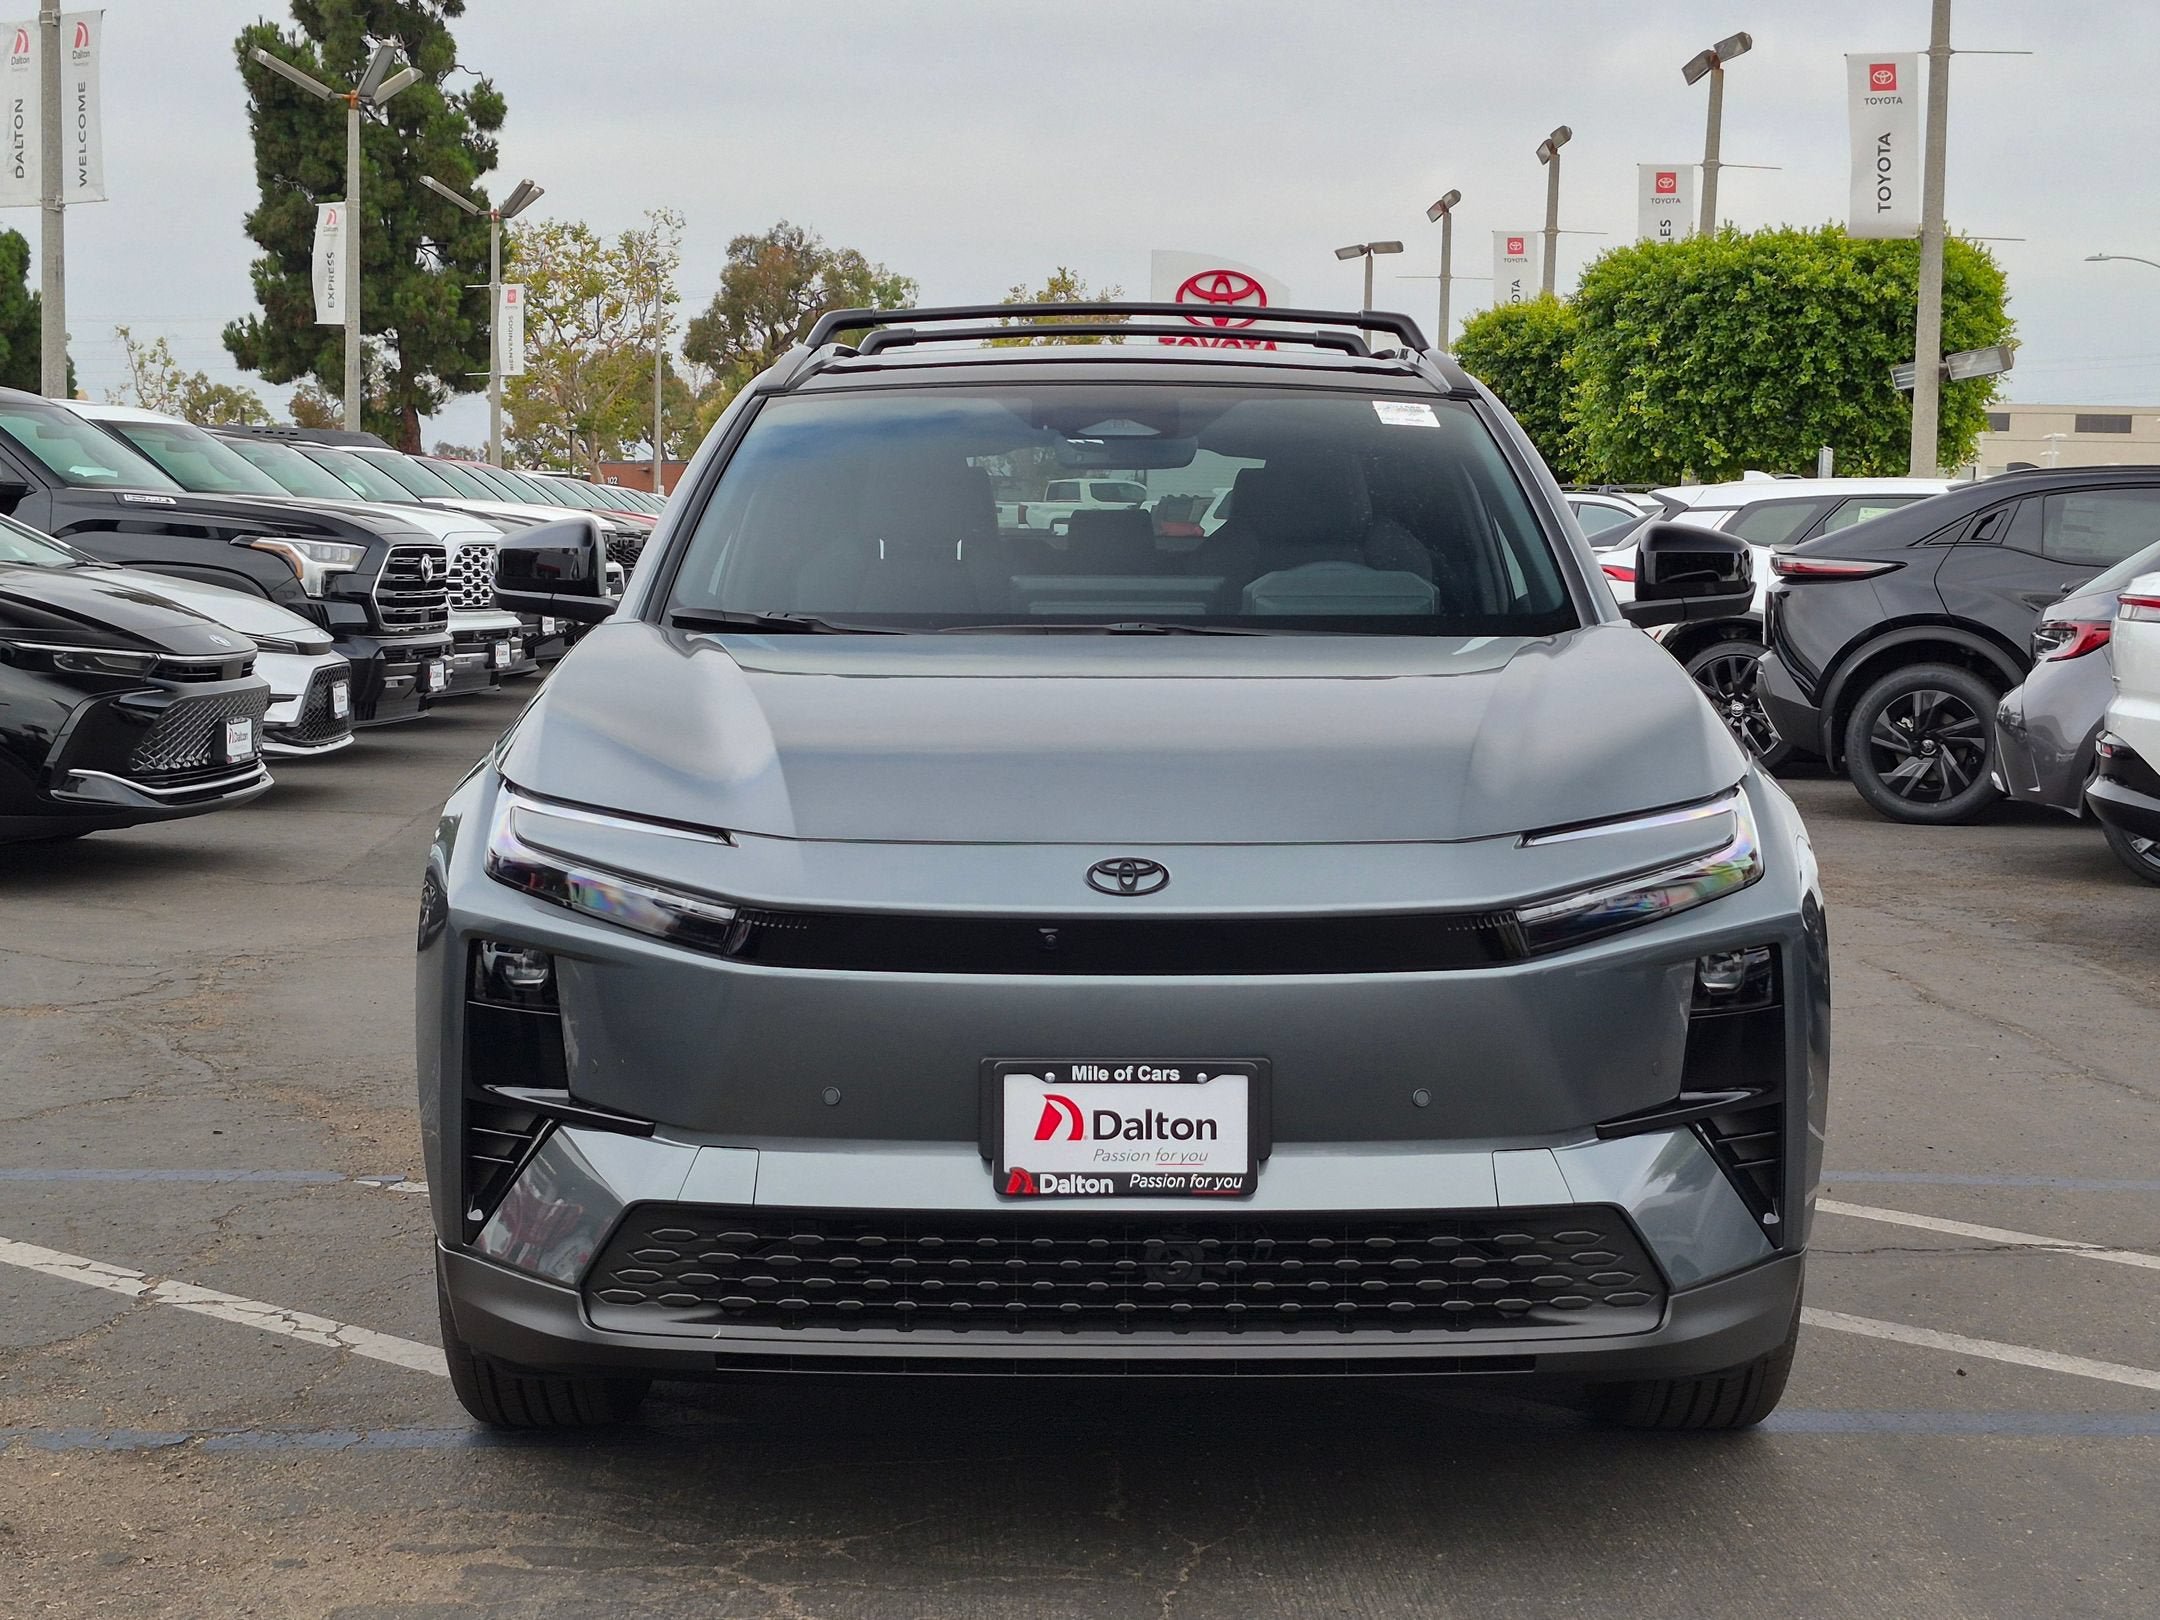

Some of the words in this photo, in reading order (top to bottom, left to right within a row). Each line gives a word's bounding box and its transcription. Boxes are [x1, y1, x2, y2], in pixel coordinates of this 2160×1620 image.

[11, 55, 30, 66] Dalton
[1864, 96, 1903, 106] TOYOTA
[14, 98, 25, 179] DALTON
[78, 81, 88, 188] WELCOME
[1877, 132, 1892, 214] TOYOTA
[326, 251, 336, 309] EXPRESS
[607, 476, 619, 485] 102
[1071, 1066, 1109, 1081] Mile
[1114, 1066, 1134, 1081] of
[1137, 1066, 1181, 1082] Cars
[1093, 1109, 1218, 1140] Dalton
[1093, 1149, 1150, 1162] Passion
[1154, 1149, 1178, 1164] for
[1180, 1152, 1208, 1165] you
[1039, 1173, 1114, 1194] Dalton
[1129, 1174, 1186, 1189] Passion
[1189, 1173, 1212, 1191] for
[1212, 1176, 1243, 1193] you
